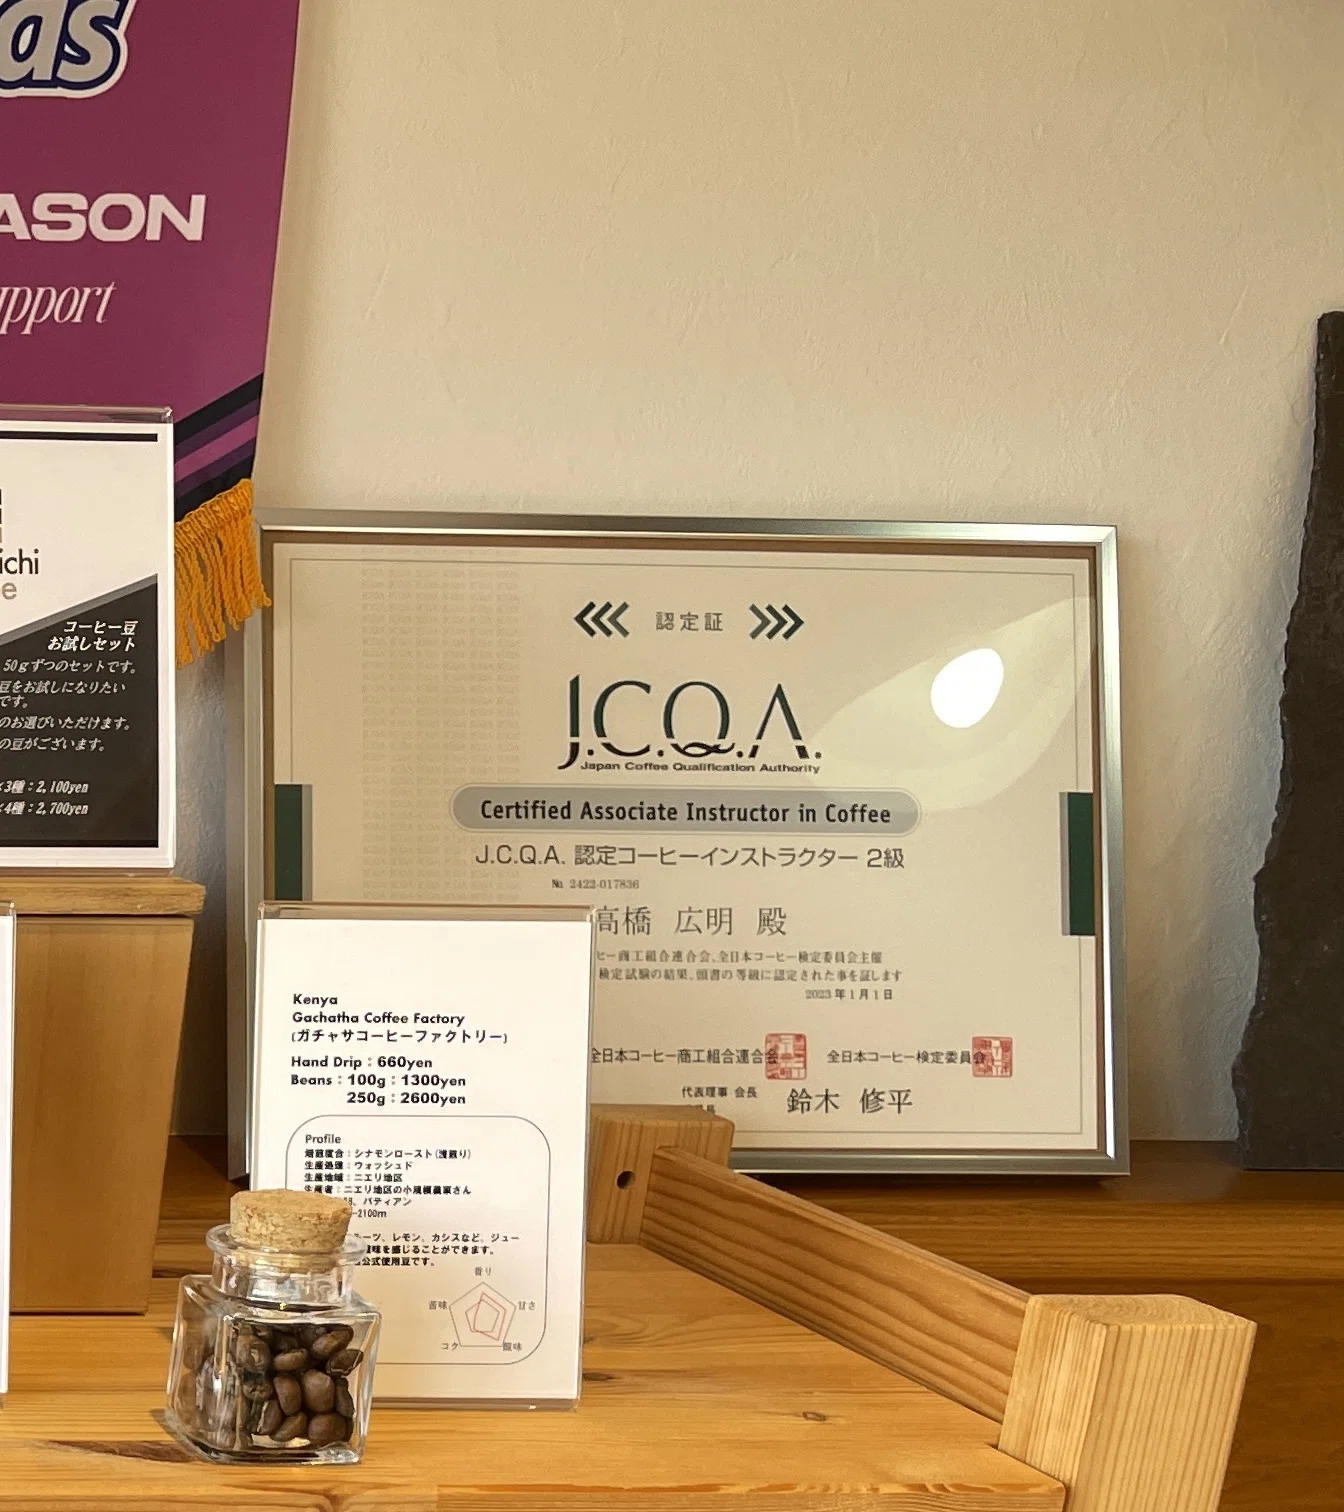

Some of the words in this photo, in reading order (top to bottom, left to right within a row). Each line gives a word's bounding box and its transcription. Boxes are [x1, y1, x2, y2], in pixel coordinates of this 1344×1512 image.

[64, 621, 138, 636] コーヒー豆
[656, 611, 724, 632] 認定証
[48, 636, 136, 651] お試しセット
[557, 673, 822, 770] J.C.Q.A.
[581, 761, 620, 772] Japan
[625, 762, 669, 772] Coffee
[673, 762, 756, 773] Qualification
[759, 762, 821, 774] Authority
[481, 800, 571, 821] Certified
[581, 801, 677, 822] Associate
[687, 802, 789, 823] Instructor
[799, 803, 816, 823] in
[826, 804, 890, 824] Coffee
[475, 846, 565, 866] J.C.Q.A.
[575, 845, 858, 867] 認定コーヒーインストラクター
[867, 848, 905, 869] 2級
[675, 907, 733, 935] 広明
[757, 907, 787, 935] 殿
[293, 994, 338, 1006] Kenya
[293, 1012, 359, 1024] Gachatha
[364, 1012, 408, 1024] Coffee
[414, 1013, 465, 1027] Factory
[292, 1029, 508, 1044] (ガチャサコーヒーファクトリー)
[291, 1056, 328, 1068] Hand
[787, 1089, 839, 1114] 鈴木
[860, 1089, 913, 1114] 修平
